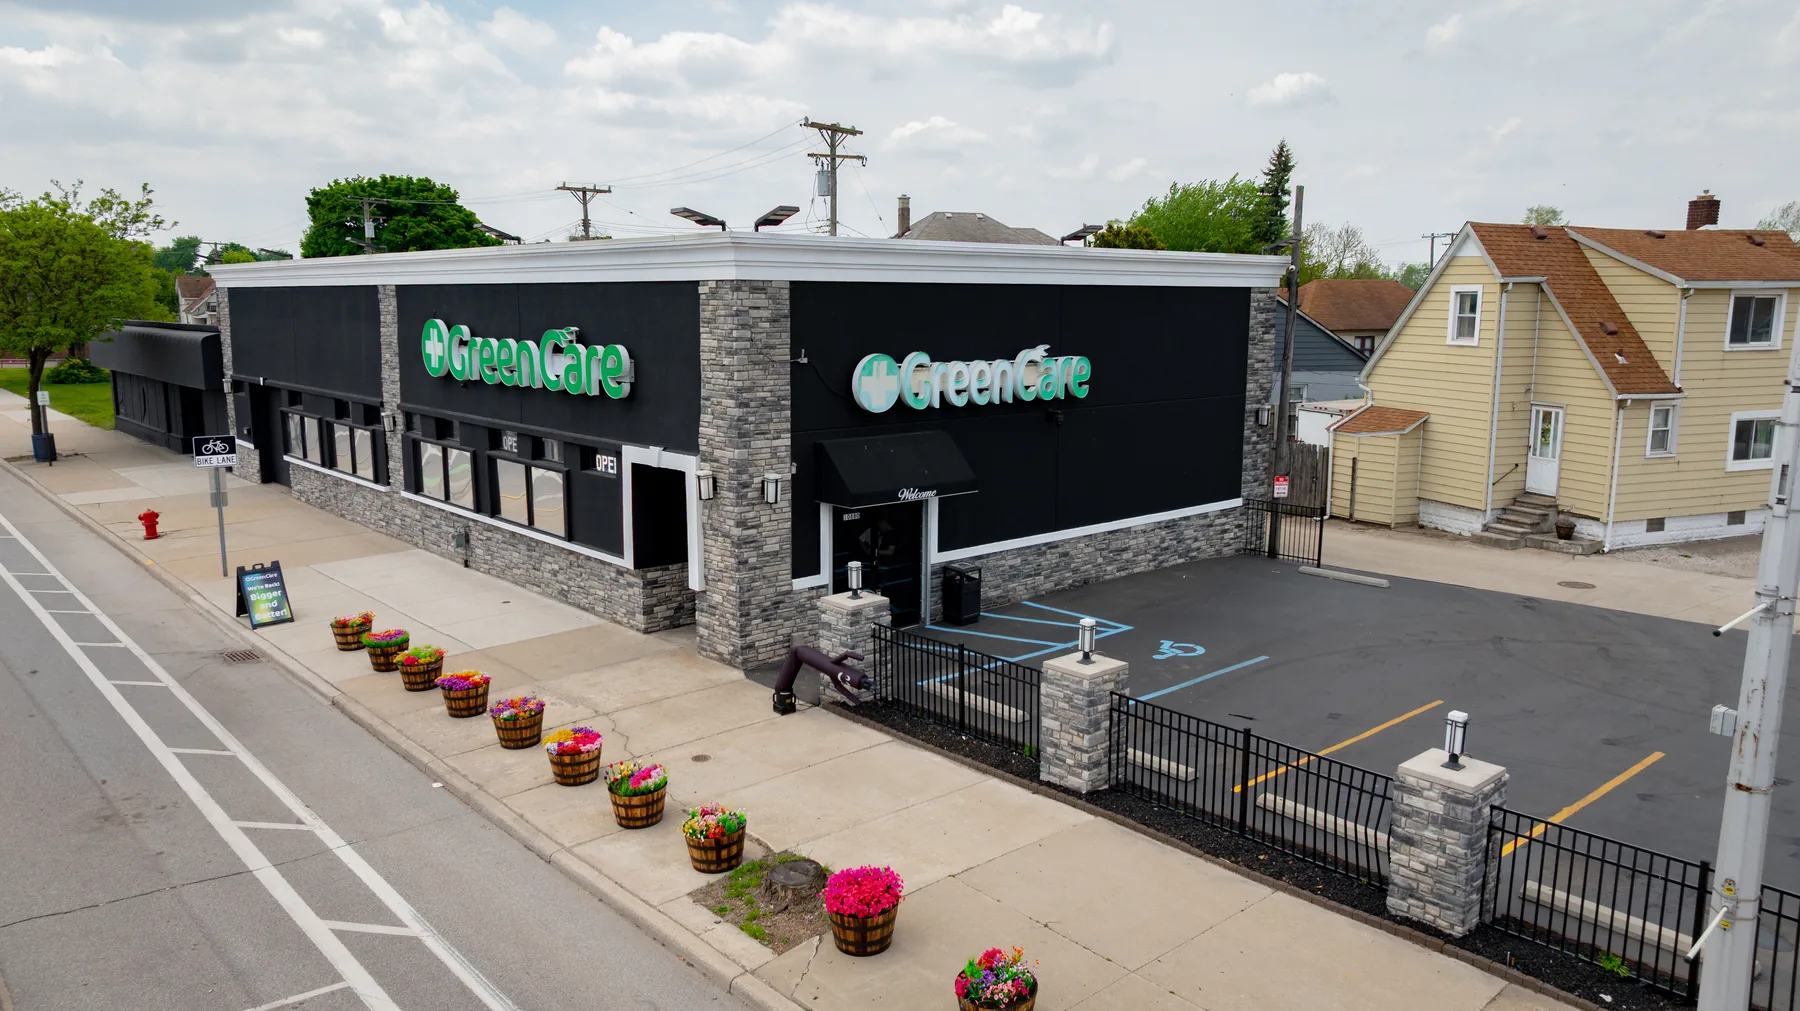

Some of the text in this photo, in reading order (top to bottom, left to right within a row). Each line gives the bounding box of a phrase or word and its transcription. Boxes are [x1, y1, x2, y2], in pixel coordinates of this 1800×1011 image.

[447, 325, 630, 399] GreenCare
[901, 345, 1091, 410] GreenCare
[502, 436, 518, 453] OPE
[197, 455, 236, 466] BIKE LANE
[898, 487, 937, 501] Welcome
[250, 590, 282, 601] Bigger
[259, 600, 278, 609] and
